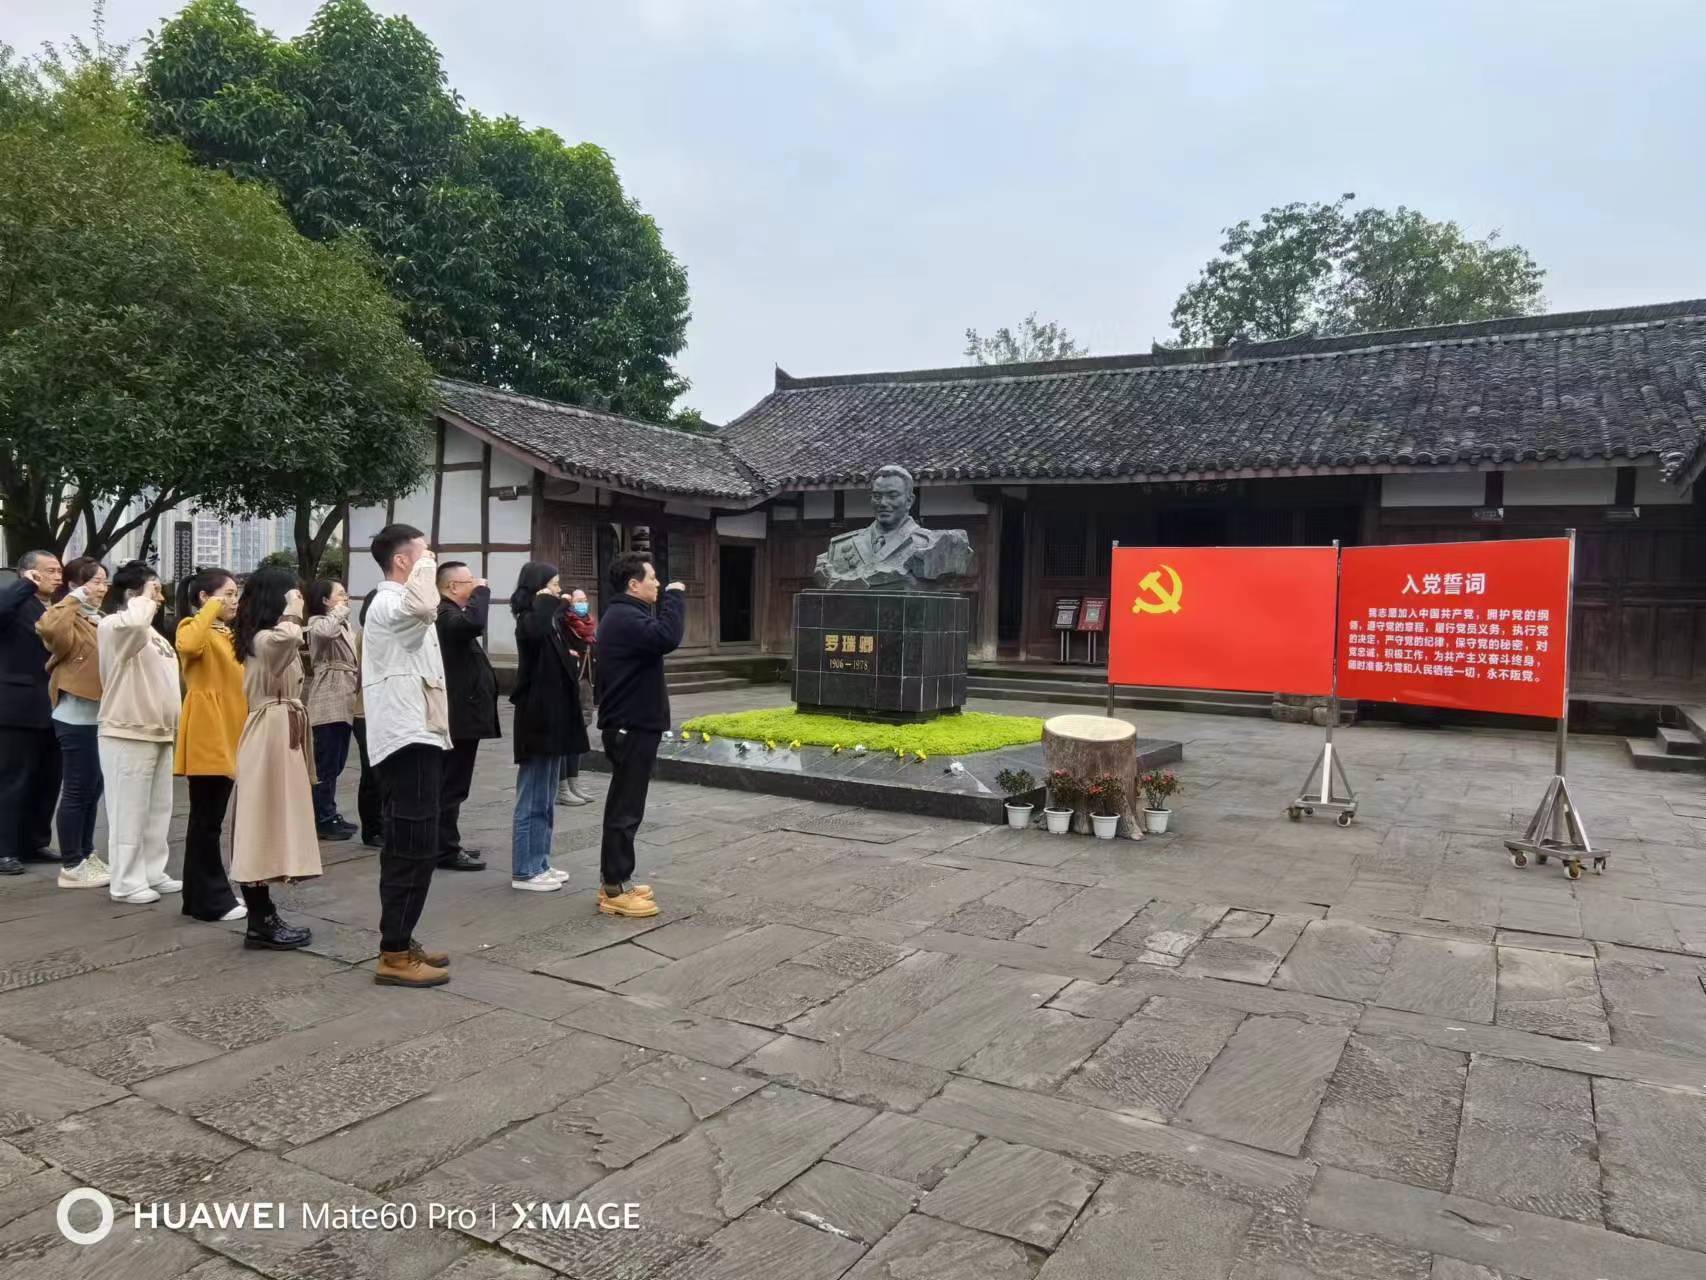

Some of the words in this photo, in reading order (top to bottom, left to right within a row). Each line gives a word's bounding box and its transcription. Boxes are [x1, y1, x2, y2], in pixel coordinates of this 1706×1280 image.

[1402, 573, 1486, 596] 入党誓词
[824, 634, 874, 654] 罗瑞卿
